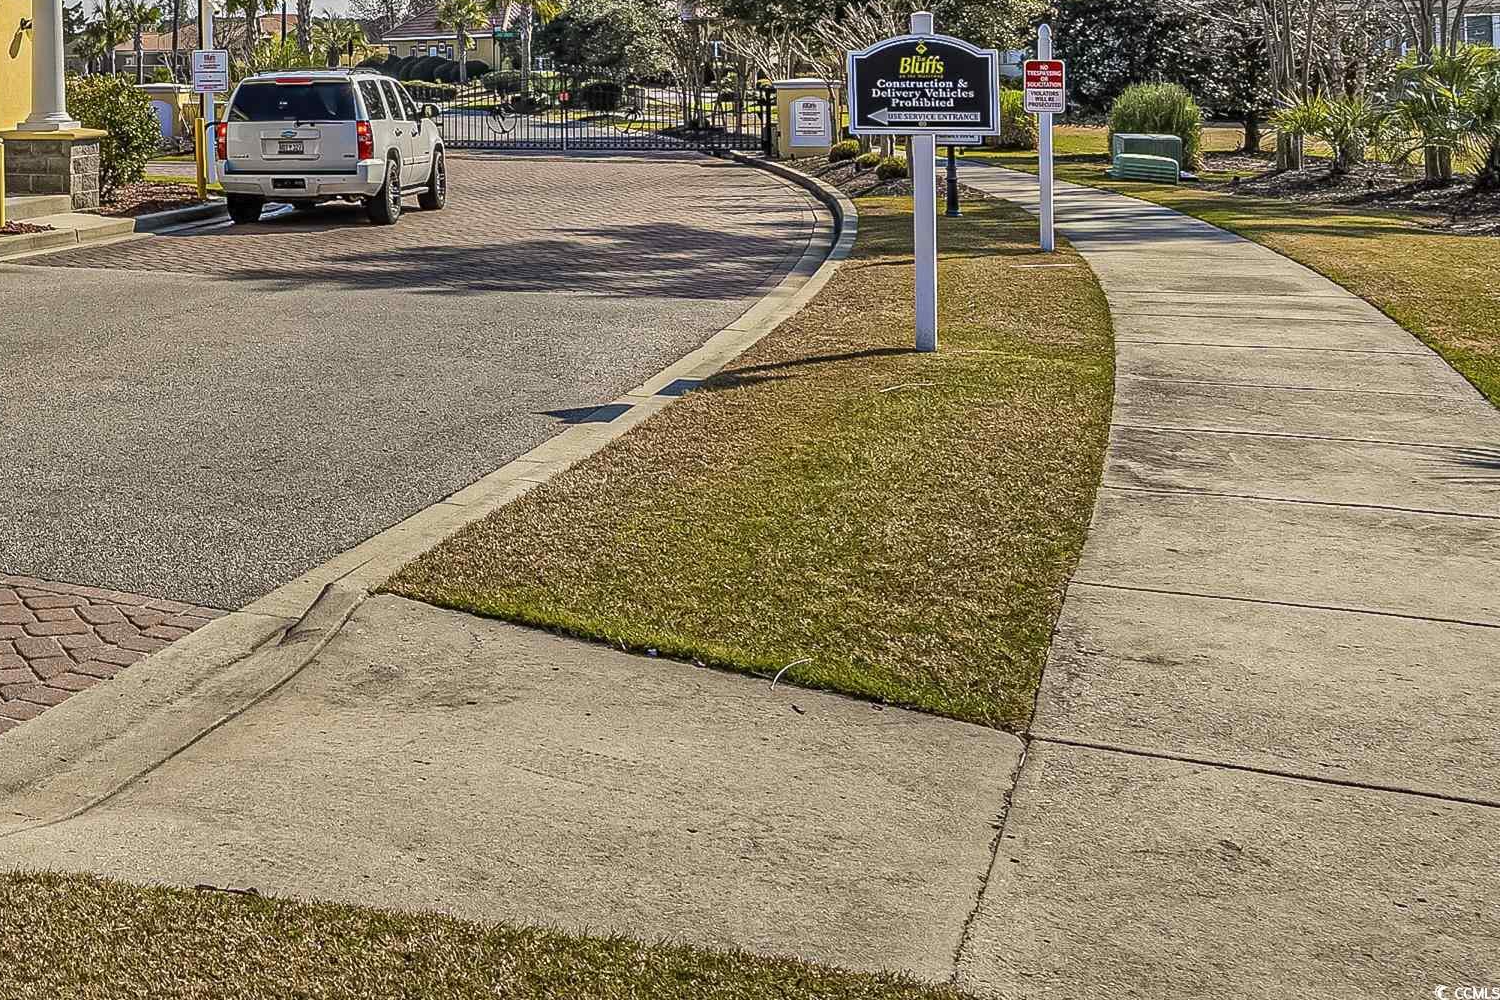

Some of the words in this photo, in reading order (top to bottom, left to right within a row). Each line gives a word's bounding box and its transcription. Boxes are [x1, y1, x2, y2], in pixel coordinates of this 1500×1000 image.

[900, 56, 944, 73] Bluffs
[876, 79, 953, 88] Construction
[958, 79, 968, 87] &
[872, 89, 920, 100] Delivery
[926, 89, 974, 98] Vehicles
[892, 98, 954, 107] Prohibited
